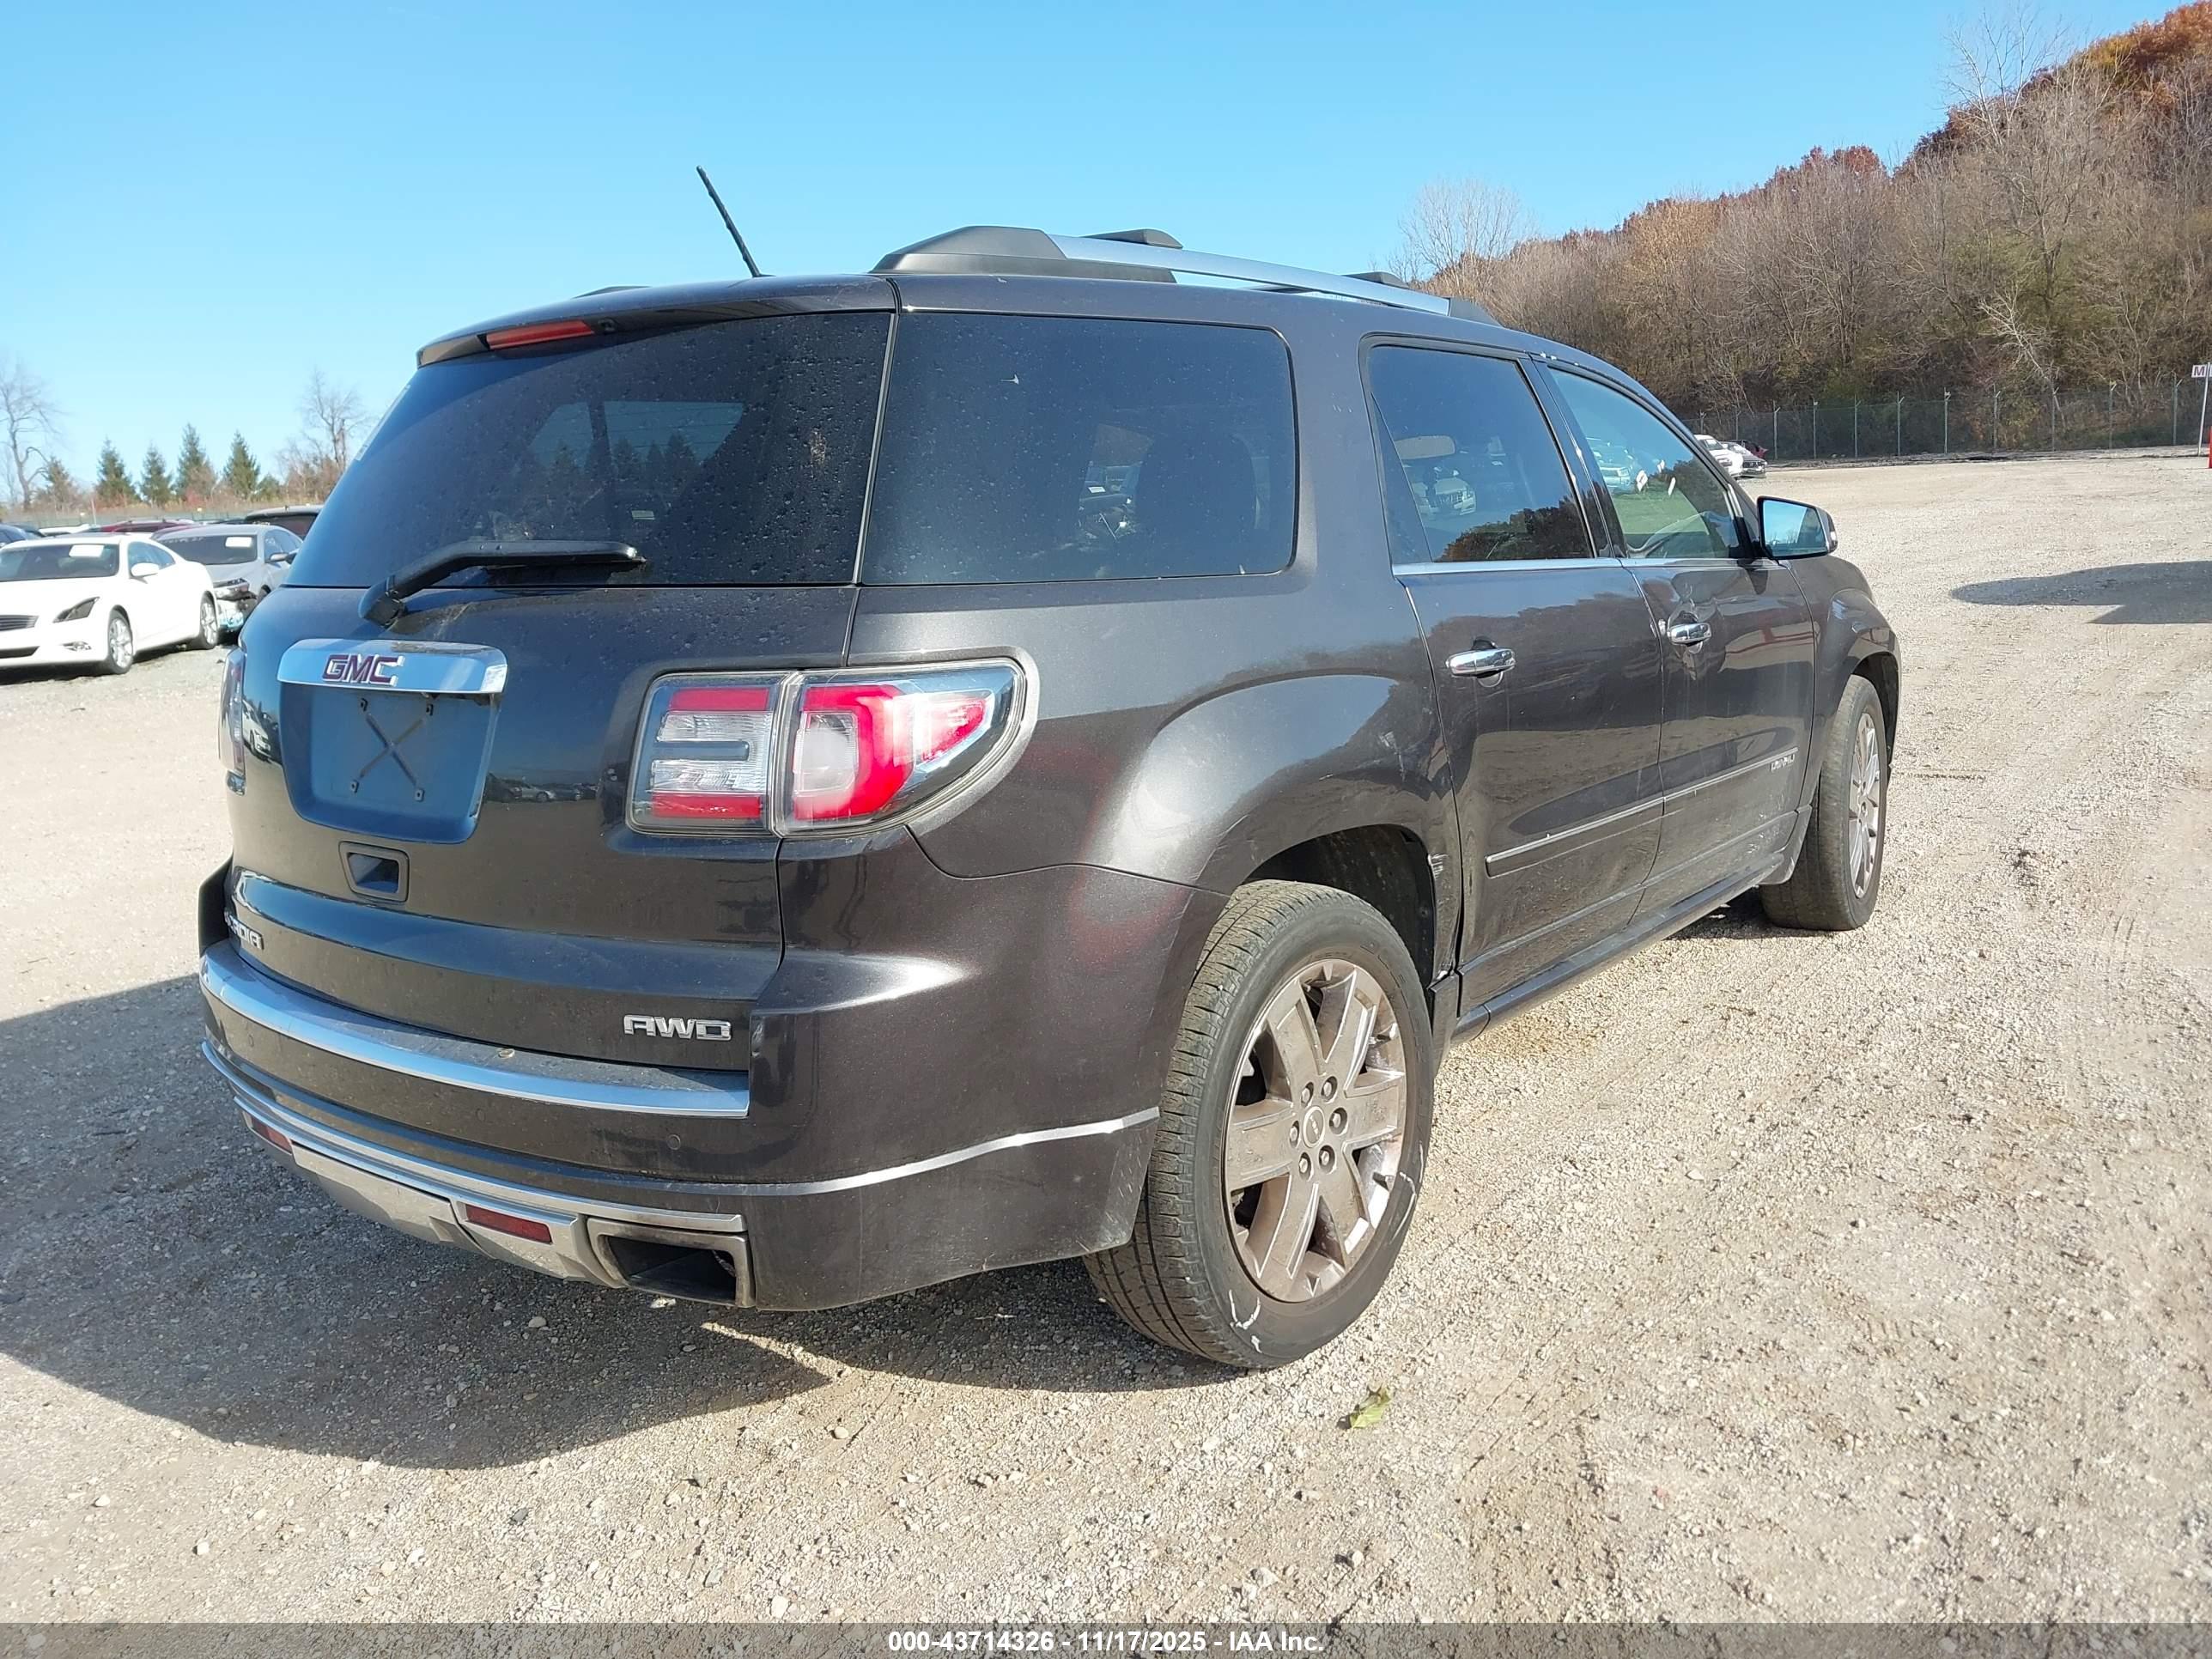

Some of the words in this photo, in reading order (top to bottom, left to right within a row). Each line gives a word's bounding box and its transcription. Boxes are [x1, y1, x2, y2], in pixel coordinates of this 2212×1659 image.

[2194, 367, 2205, 376] M
[323, 655, 404, 686] GMC
[623, 1014, 732, 1041] AWD
